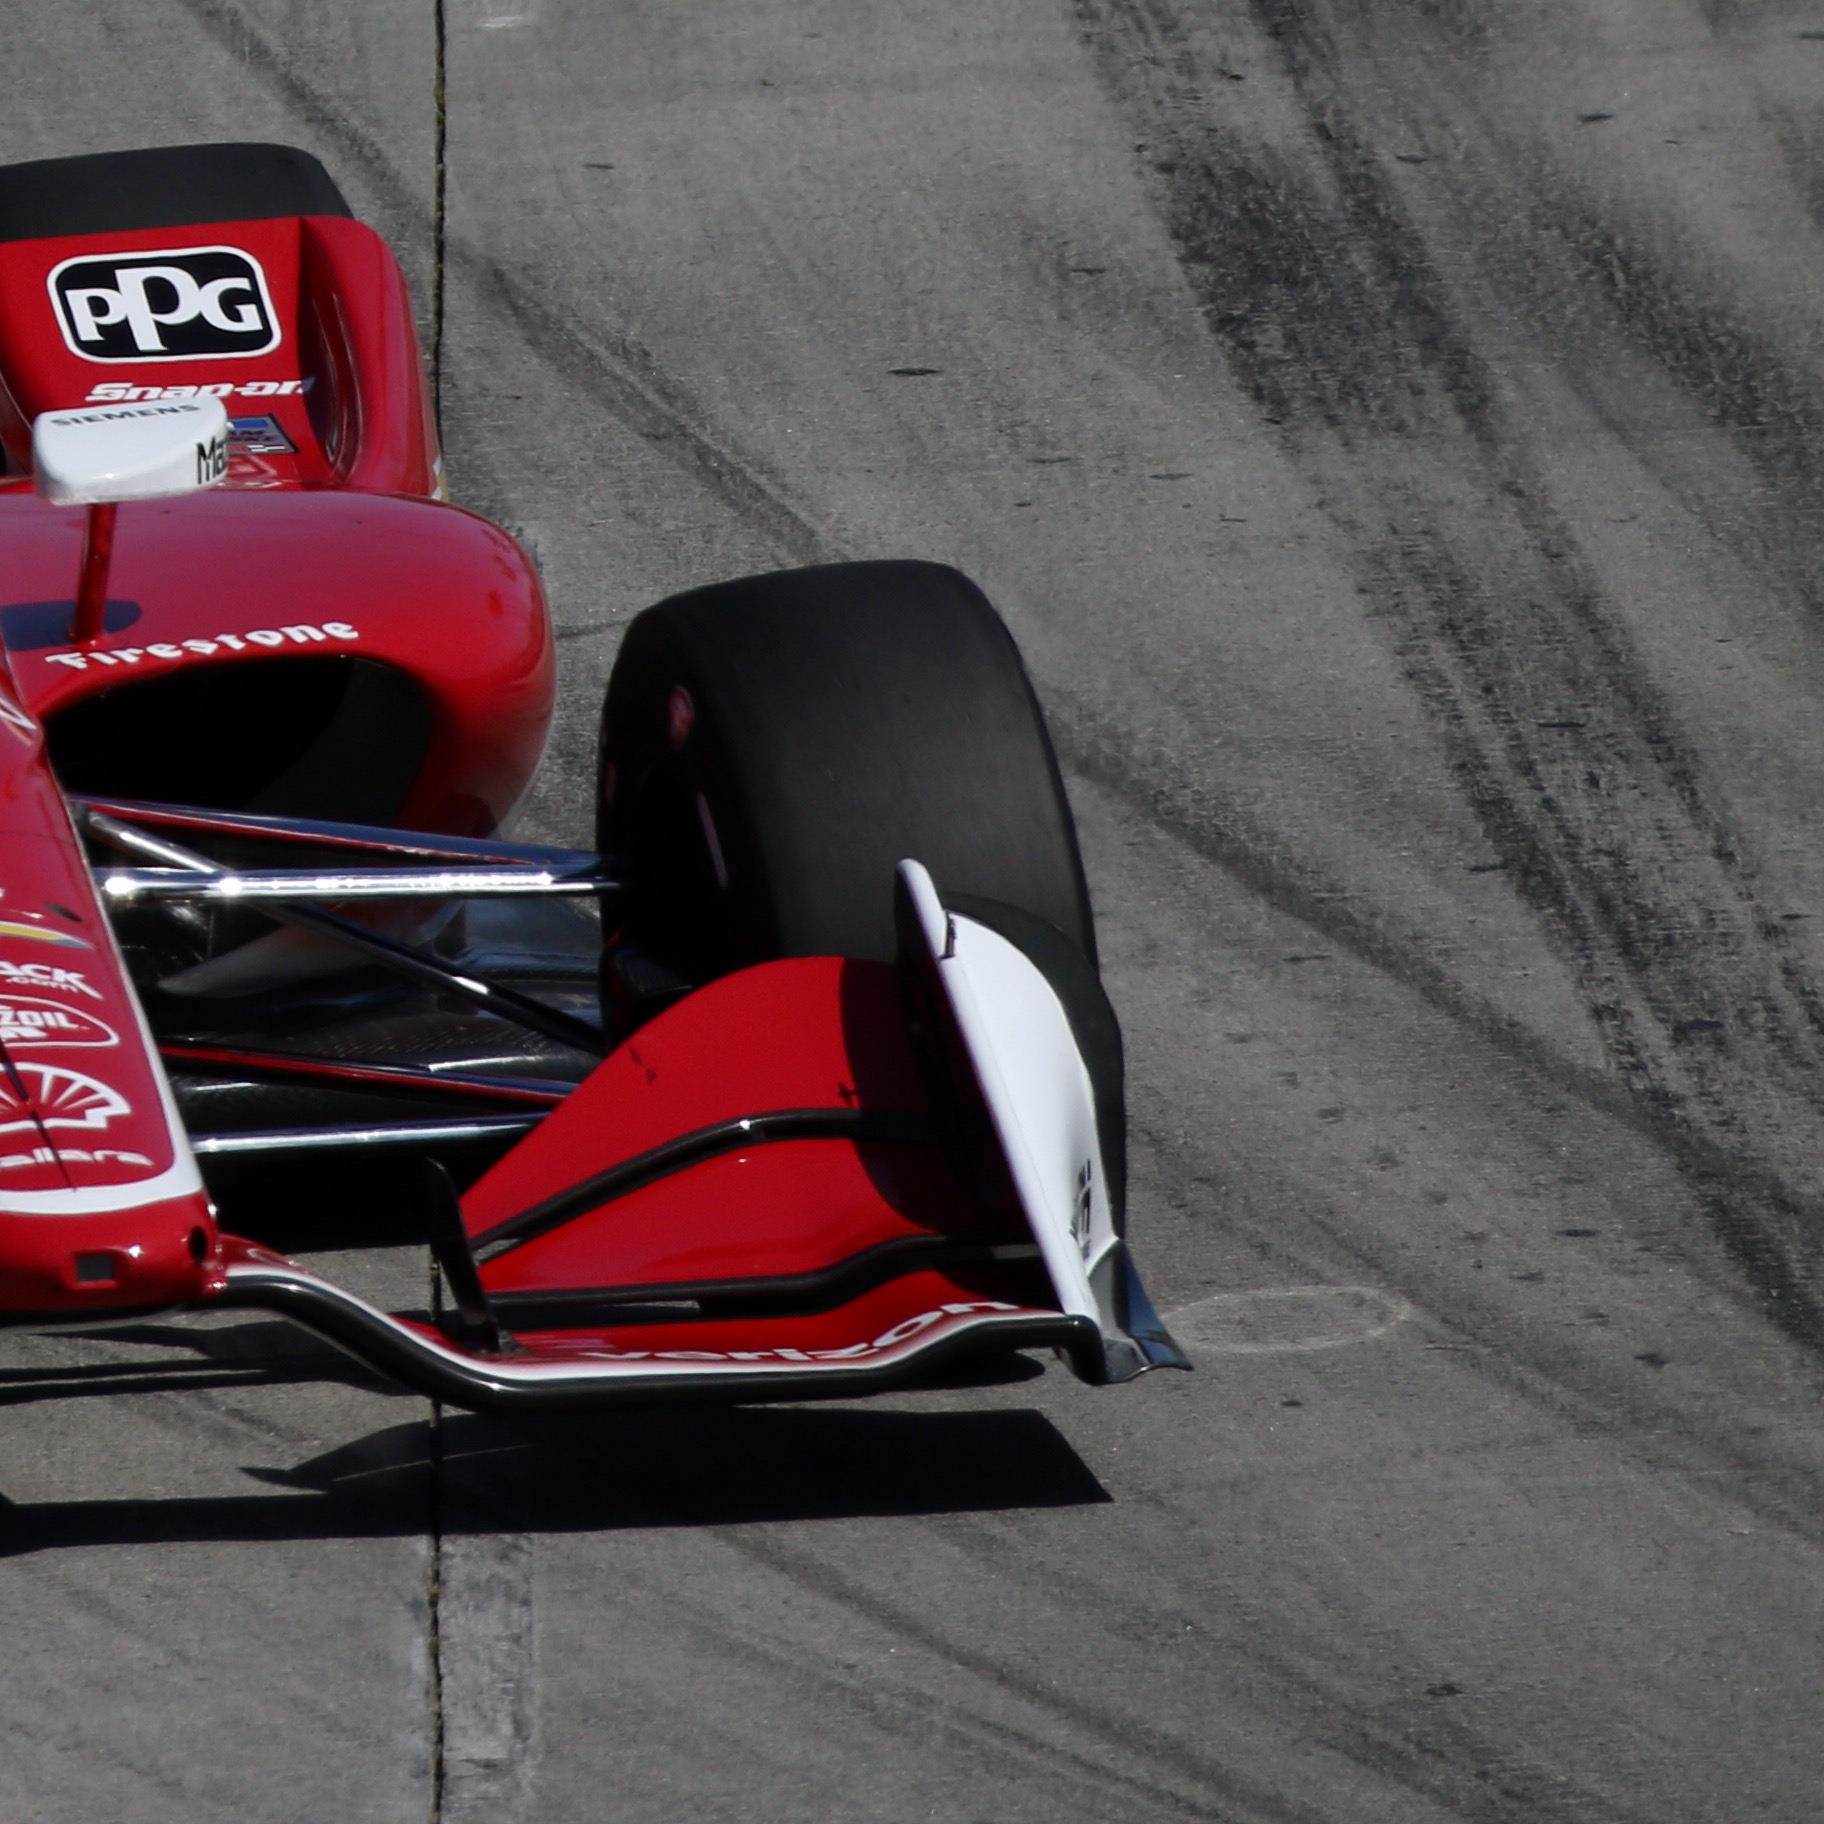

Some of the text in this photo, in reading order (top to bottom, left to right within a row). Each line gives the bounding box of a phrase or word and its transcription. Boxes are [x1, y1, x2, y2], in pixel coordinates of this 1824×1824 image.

[64, 264, 264, 351] PPG
[50, 403, 200, 427] SIEMENS
[44, 617, 359, 671] Firestone
[578, 1300, 1020, 1362] verizon
